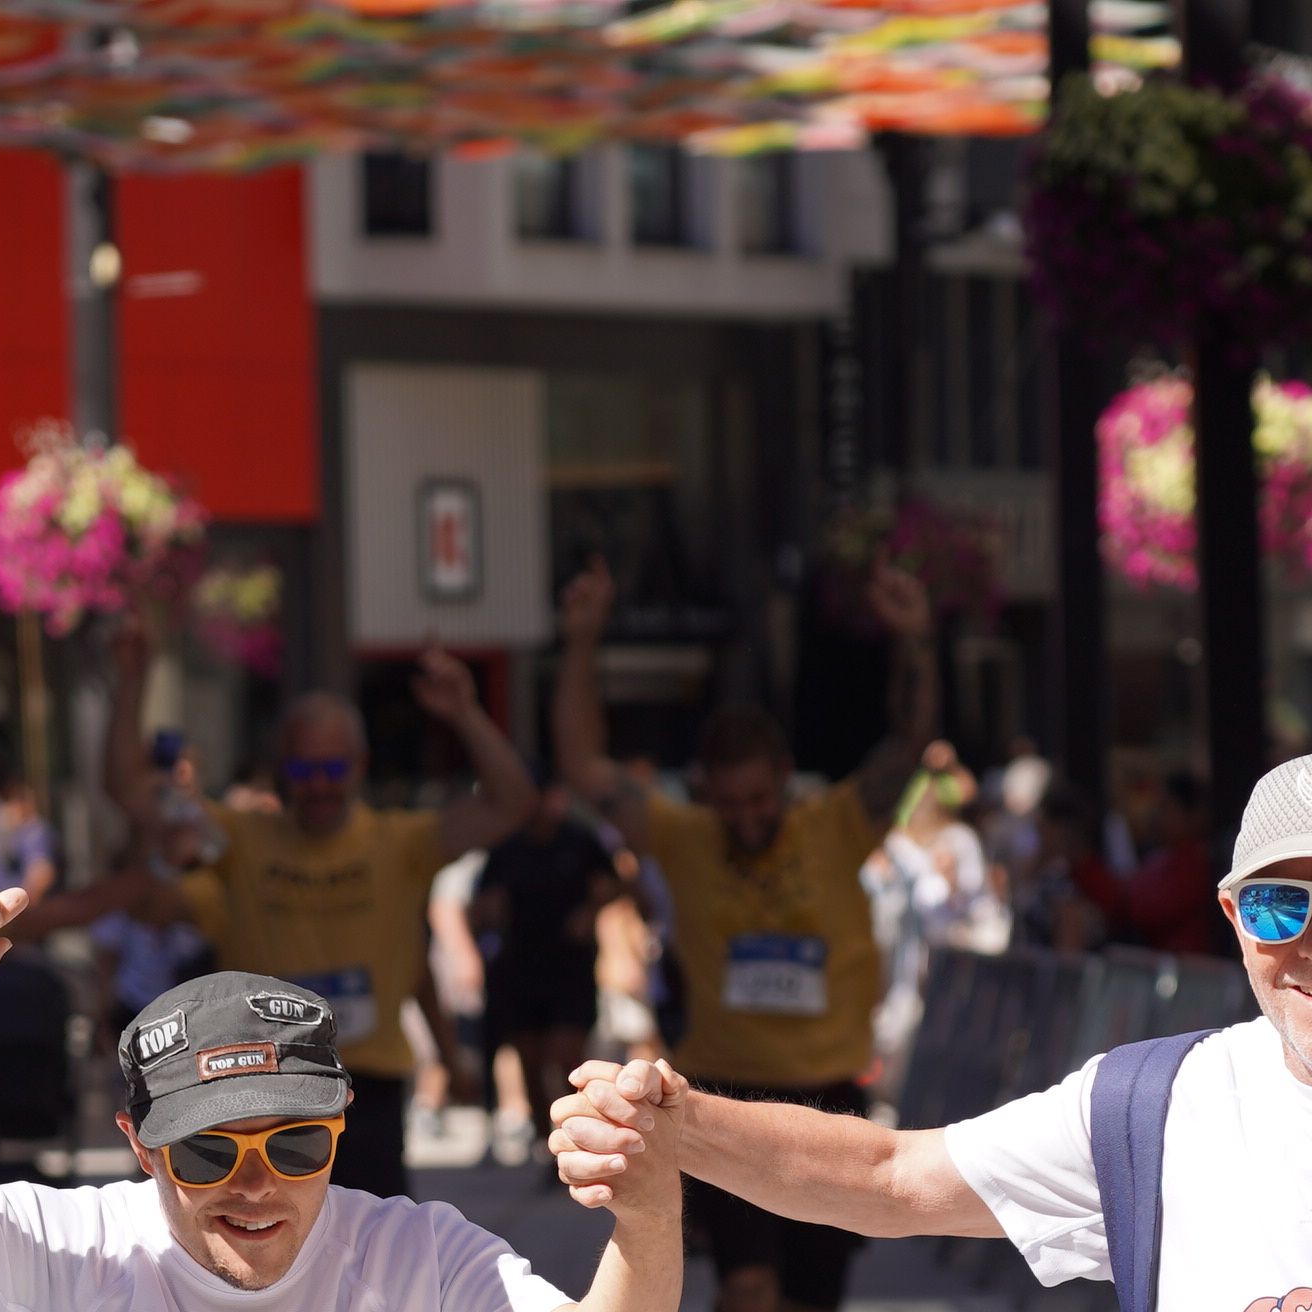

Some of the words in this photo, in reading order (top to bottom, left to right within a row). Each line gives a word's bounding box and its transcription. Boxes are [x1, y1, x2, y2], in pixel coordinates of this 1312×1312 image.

[269, 999, 305, 1018] GUN
[138, 1021, 179, 1059] TOP
[209, 1059, 235, 1070] TOP
[238, 1054, 265, 1066] GUN
